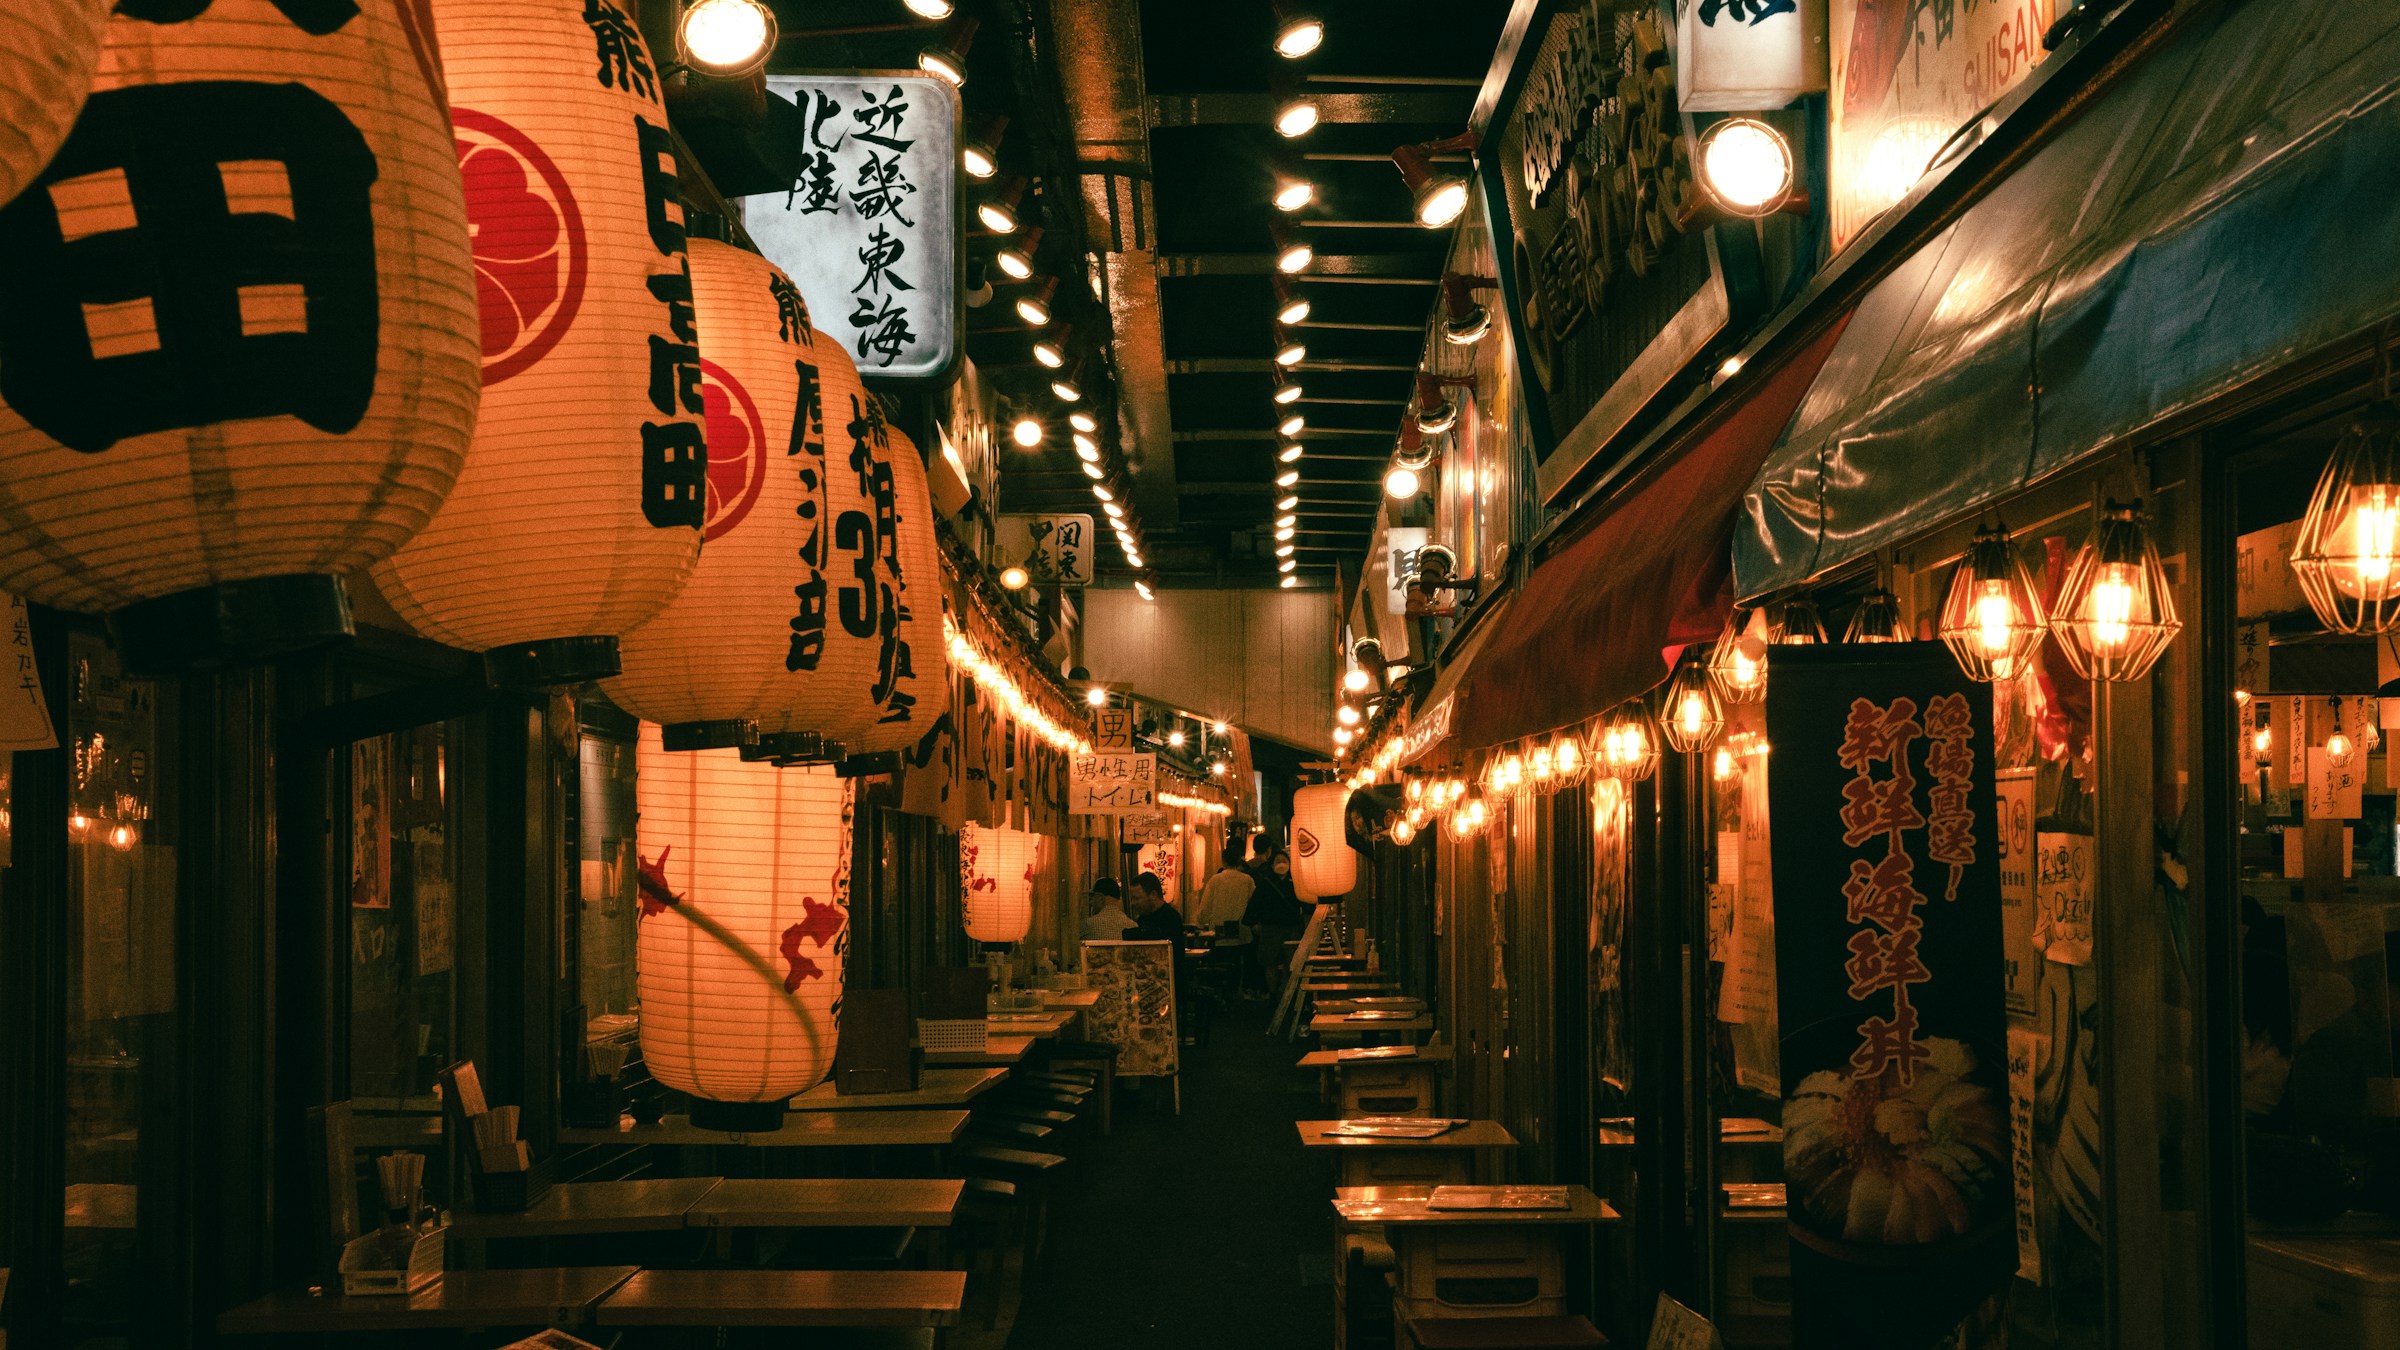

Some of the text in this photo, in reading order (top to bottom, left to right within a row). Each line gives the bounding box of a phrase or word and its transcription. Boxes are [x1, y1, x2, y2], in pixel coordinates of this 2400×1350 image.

[786, 89, 848, 215] 北陸
[848, 84, 916, 368] 近畿東海
[1056, 521, 1082, 579] 関東
[1101, 714, 1127, 748] 男
[1923, 692, 1976, 902] 漁場直送!
[1837, 696, 1932, 1088] 新鮮海鮮丼
